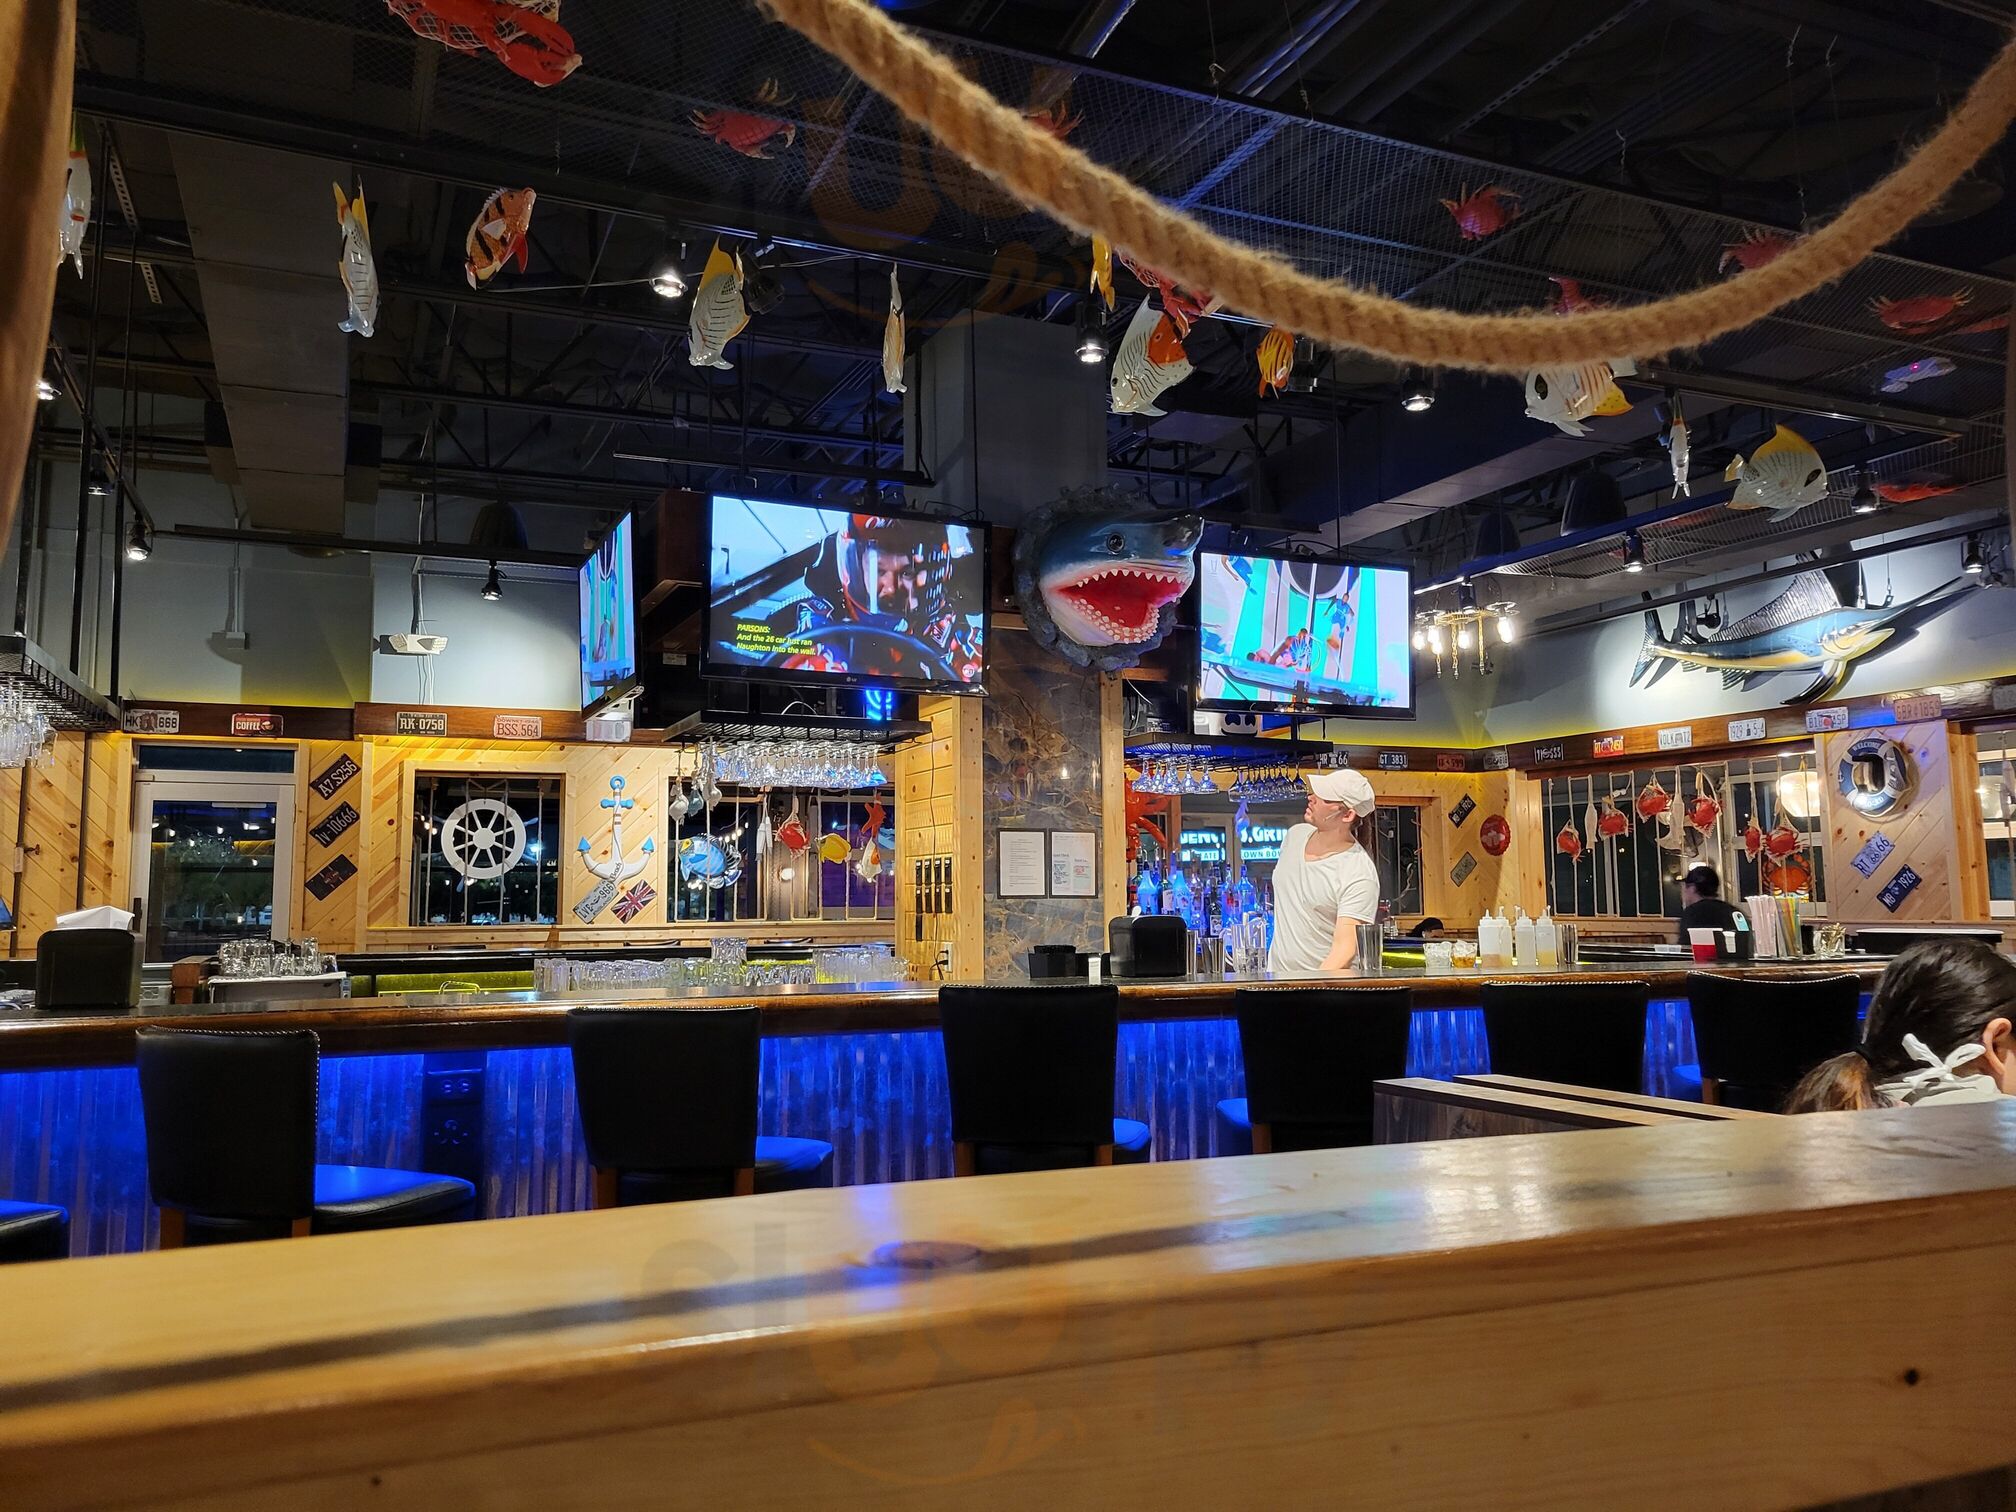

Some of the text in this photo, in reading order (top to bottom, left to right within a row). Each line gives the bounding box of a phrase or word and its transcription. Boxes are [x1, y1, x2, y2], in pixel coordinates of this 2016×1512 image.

[737, 624, 771, 633] PARSONS:
[753, 634, 764, 642] the
[765, 635, 775, 643] 26
[736, 642, 771, 652] Naughton
[788, 646, 799, 654] the
[159, 716, 177, 729] 668
[236, 721, 260, 731] COFFEE
[1876, 837, 1890, 852] 66
[1897, 870, 1916, 889] 1926
[599, 883, 614, 898] 966
